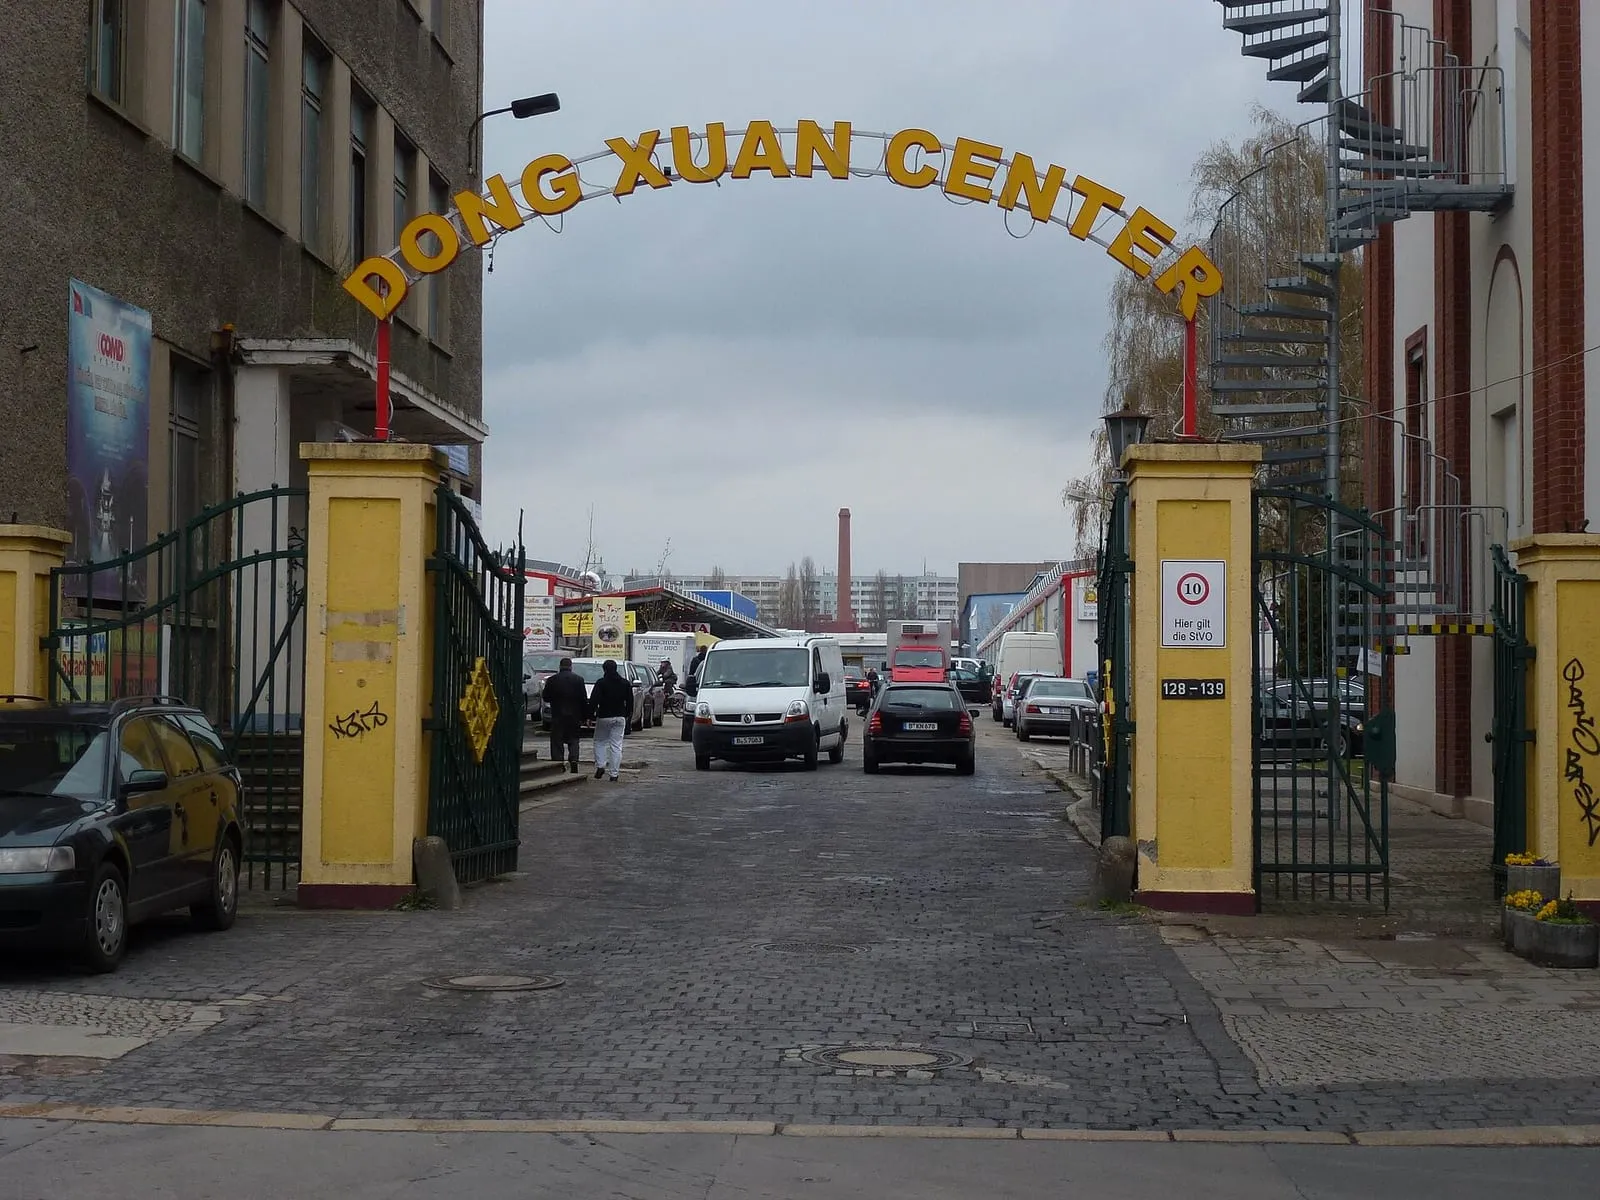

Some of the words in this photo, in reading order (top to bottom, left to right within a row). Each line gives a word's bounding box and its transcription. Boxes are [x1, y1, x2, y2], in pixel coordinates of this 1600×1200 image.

[342, 154, 584, 321] DONG
[605, 120, 852, 198] XUAN
[885, 128, 1225, 322] CENTER
[1184, 583, 1202, 596] 10
[670, 622, 709, 634] ASIA
[1174, 618, 1193, 629] Hier
[1196, 618, 1211, 631] gilt
[1172, 631, 1187, 641] die
[1188, 631, 1213, 642] StVO
